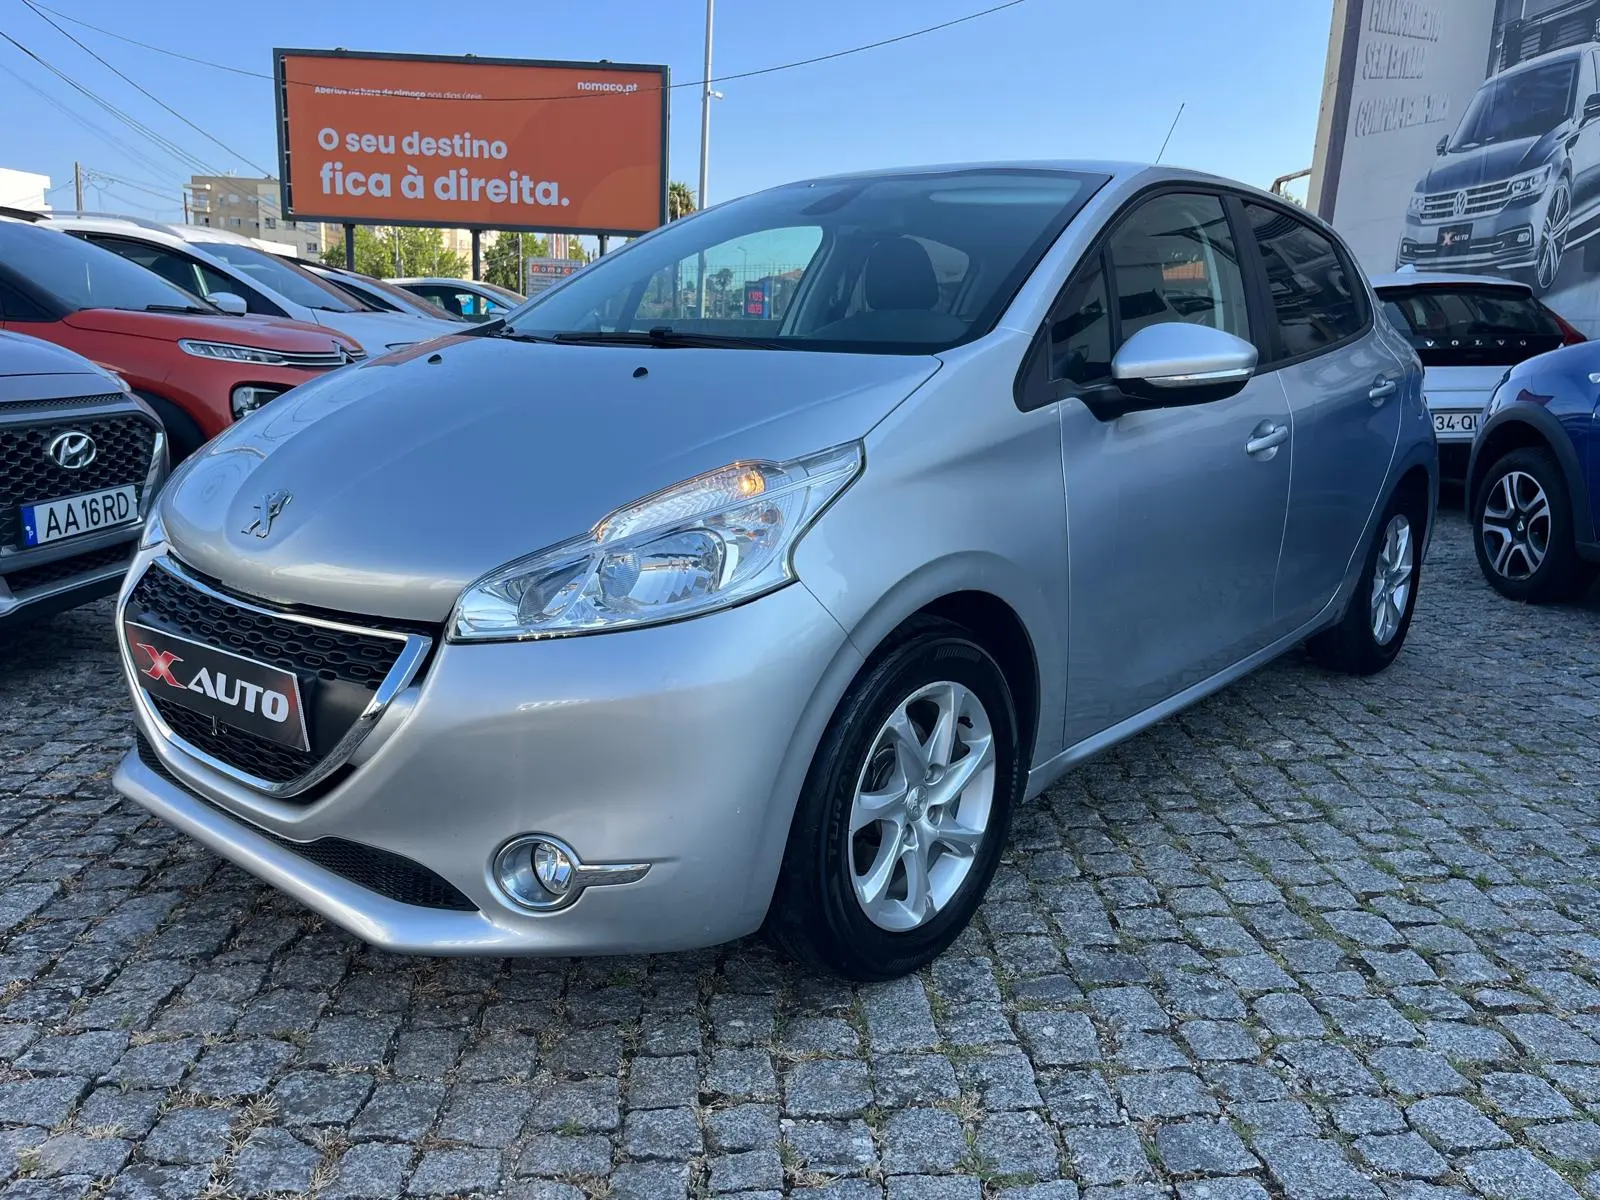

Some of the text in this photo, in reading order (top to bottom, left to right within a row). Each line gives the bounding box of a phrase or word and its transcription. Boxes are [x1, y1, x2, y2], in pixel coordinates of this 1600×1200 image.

[577, 81, 638, 96] nomaco.pt
[318, 127, 508, 160] O seu destino
[320, 161, 570, 207] fica à direita.
[1425, 339, 1527, 347] VOLVO
[136, 643, 289, 723] X AUTO
